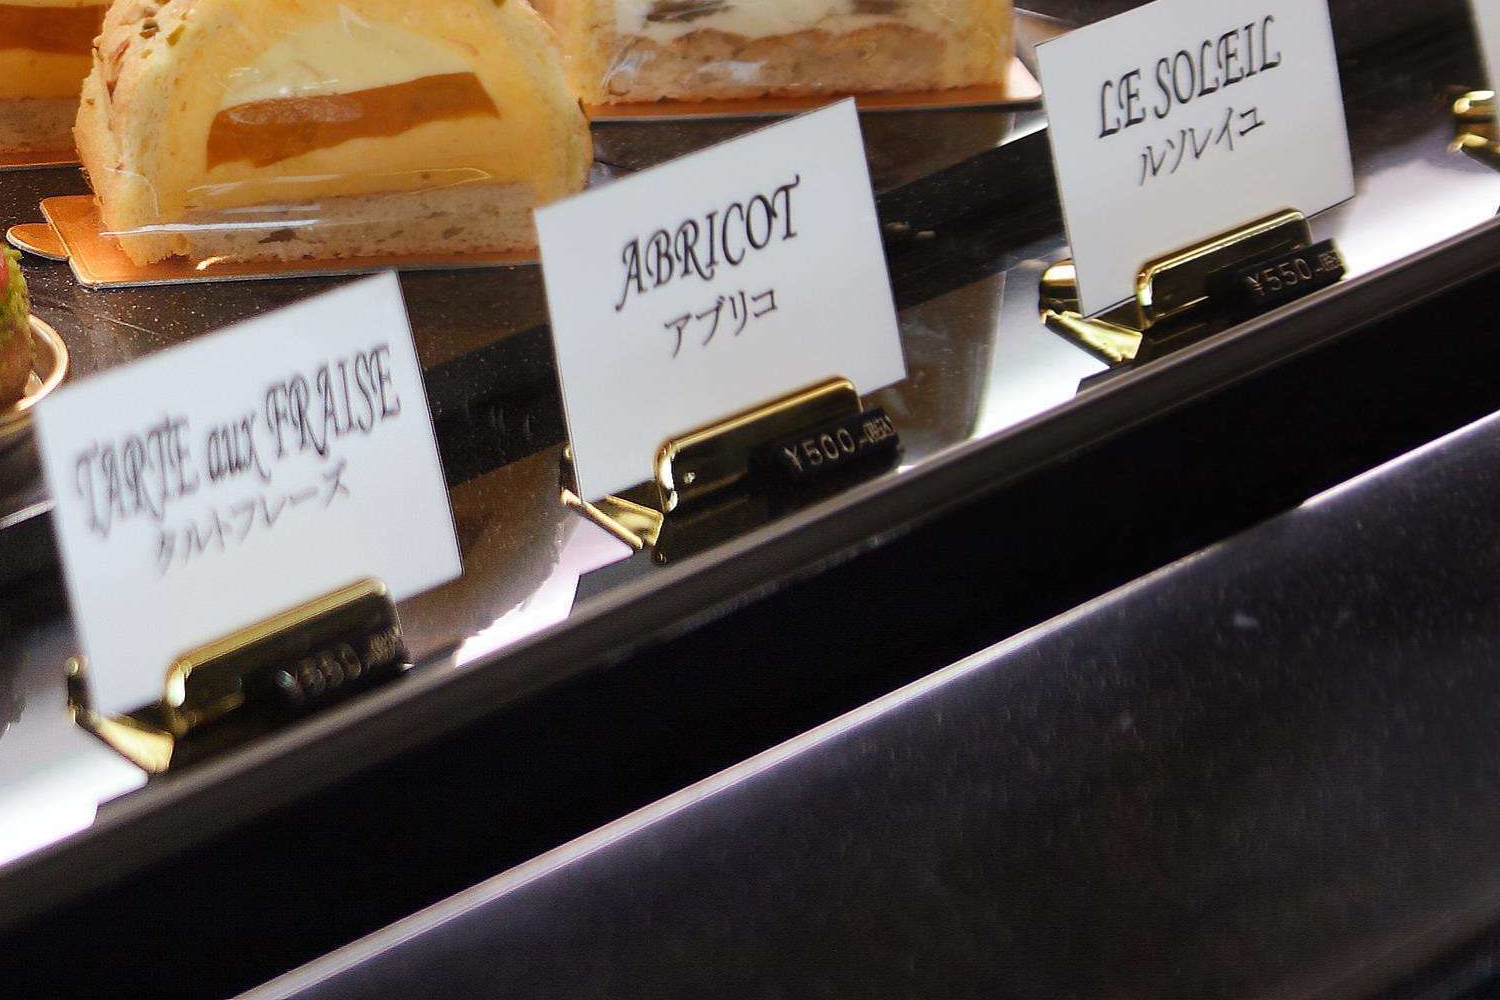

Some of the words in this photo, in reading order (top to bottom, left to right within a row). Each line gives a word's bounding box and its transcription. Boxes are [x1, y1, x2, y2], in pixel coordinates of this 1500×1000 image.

[1098, 67, 1146, 139] LE
[1154, 14, 1282, 119] SOLEIL
[1139, 105, 1265, 186] ルソレイユ
[615, 174, 800, 312] ABRICOT
[664, 290, 778, 358] アブリコ
[74, 413, 201, 538] TARTE
[207, 409, 271, 484] aux
[265, 344, 402, 458] FRAISE
